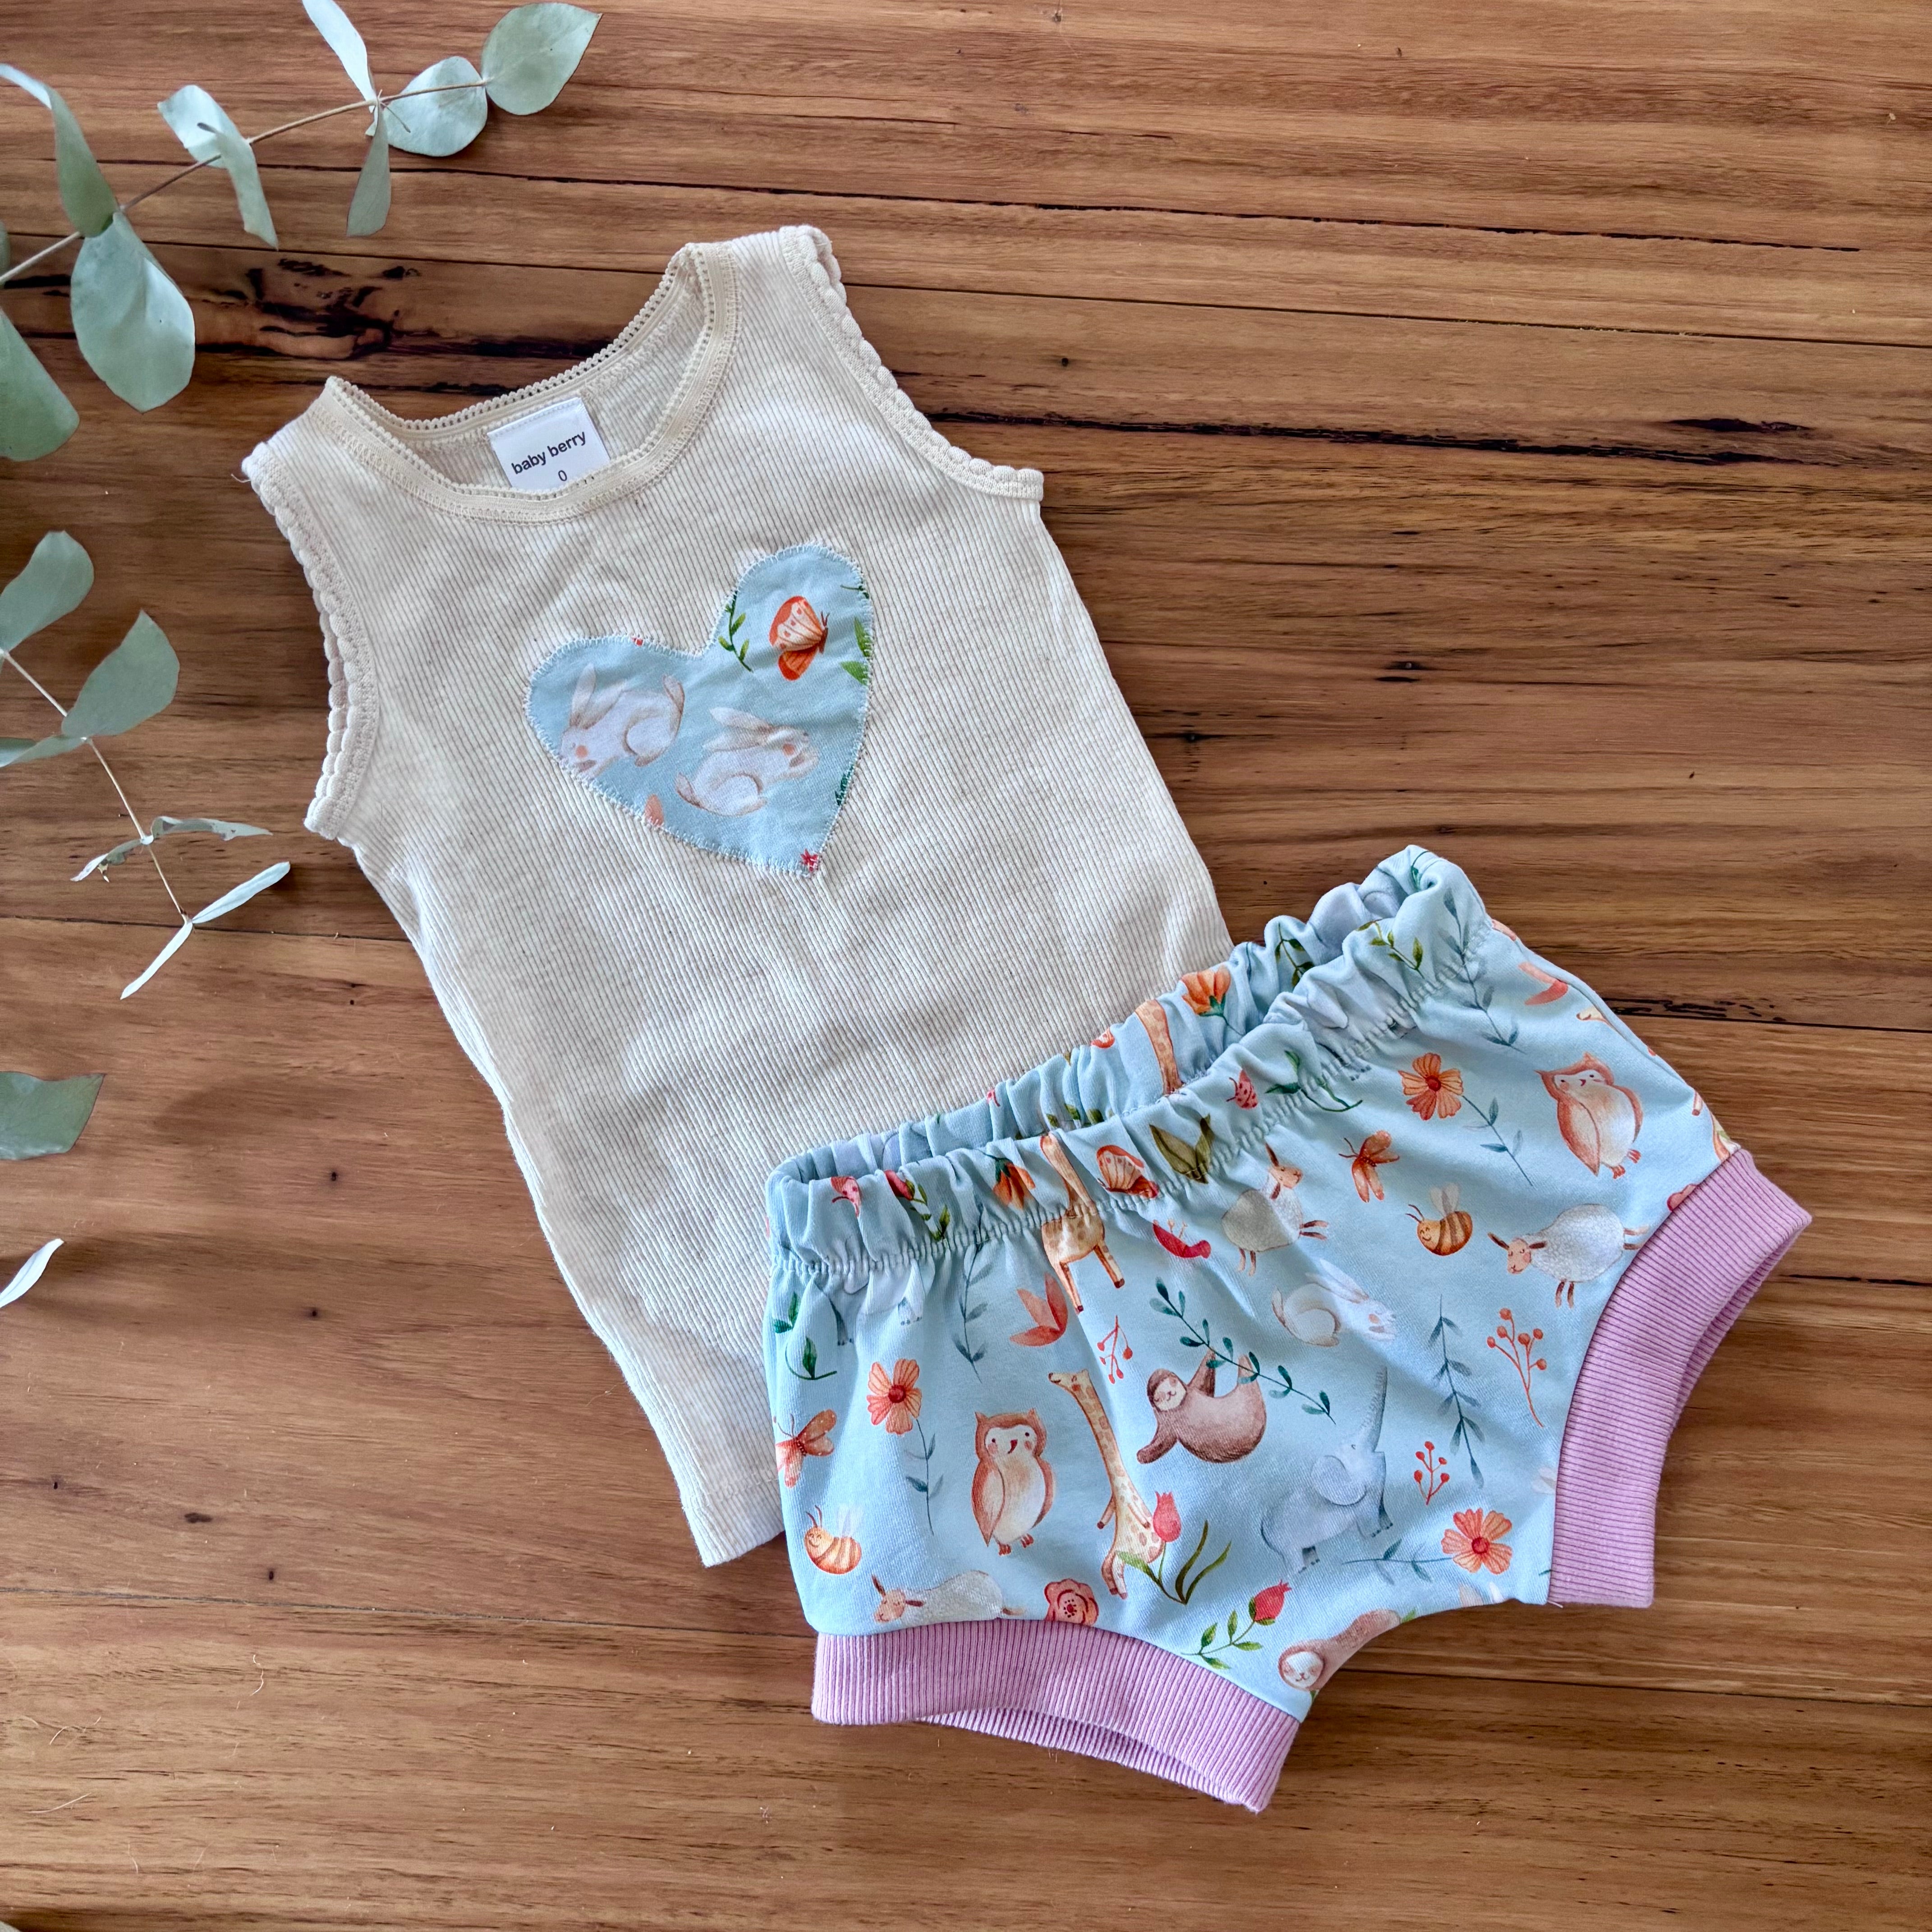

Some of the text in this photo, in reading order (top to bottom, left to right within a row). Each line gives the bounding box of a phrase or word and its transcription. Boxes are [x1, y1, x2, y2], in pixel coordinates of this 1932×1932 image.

[511, 432, 586, 474] baby berry
[558, 470, 567, 481] 0
